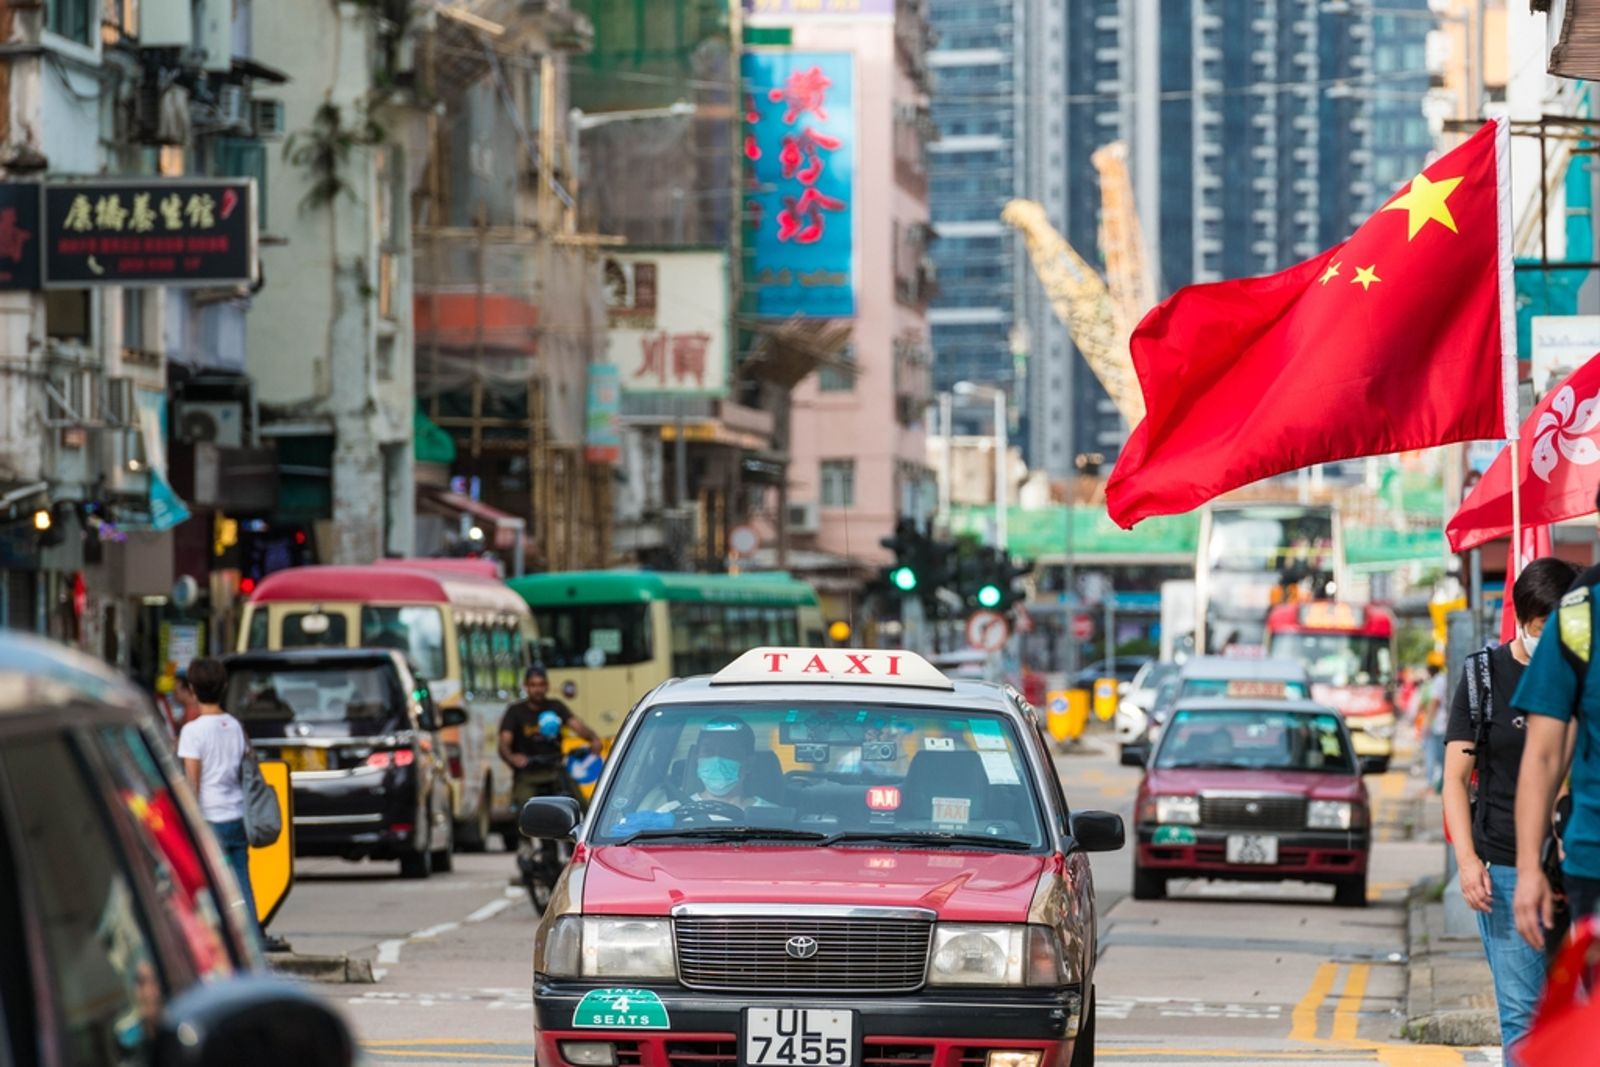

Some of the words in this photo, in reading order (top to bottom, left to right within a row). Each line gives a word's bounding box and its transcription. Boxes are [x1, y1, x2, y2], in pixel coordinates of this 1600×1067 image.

[764, 653, 902, 675] TAXI
[870, 789, 898, 807] TAXI
[935, 803, 968, 819] TAXI
[611, 995, 630, 1013] 4
[593, 1015, 650, 1025] SEATS
[776, 1009, 822, 1037] UL
[752, 1036, 847, 1065] 7455
